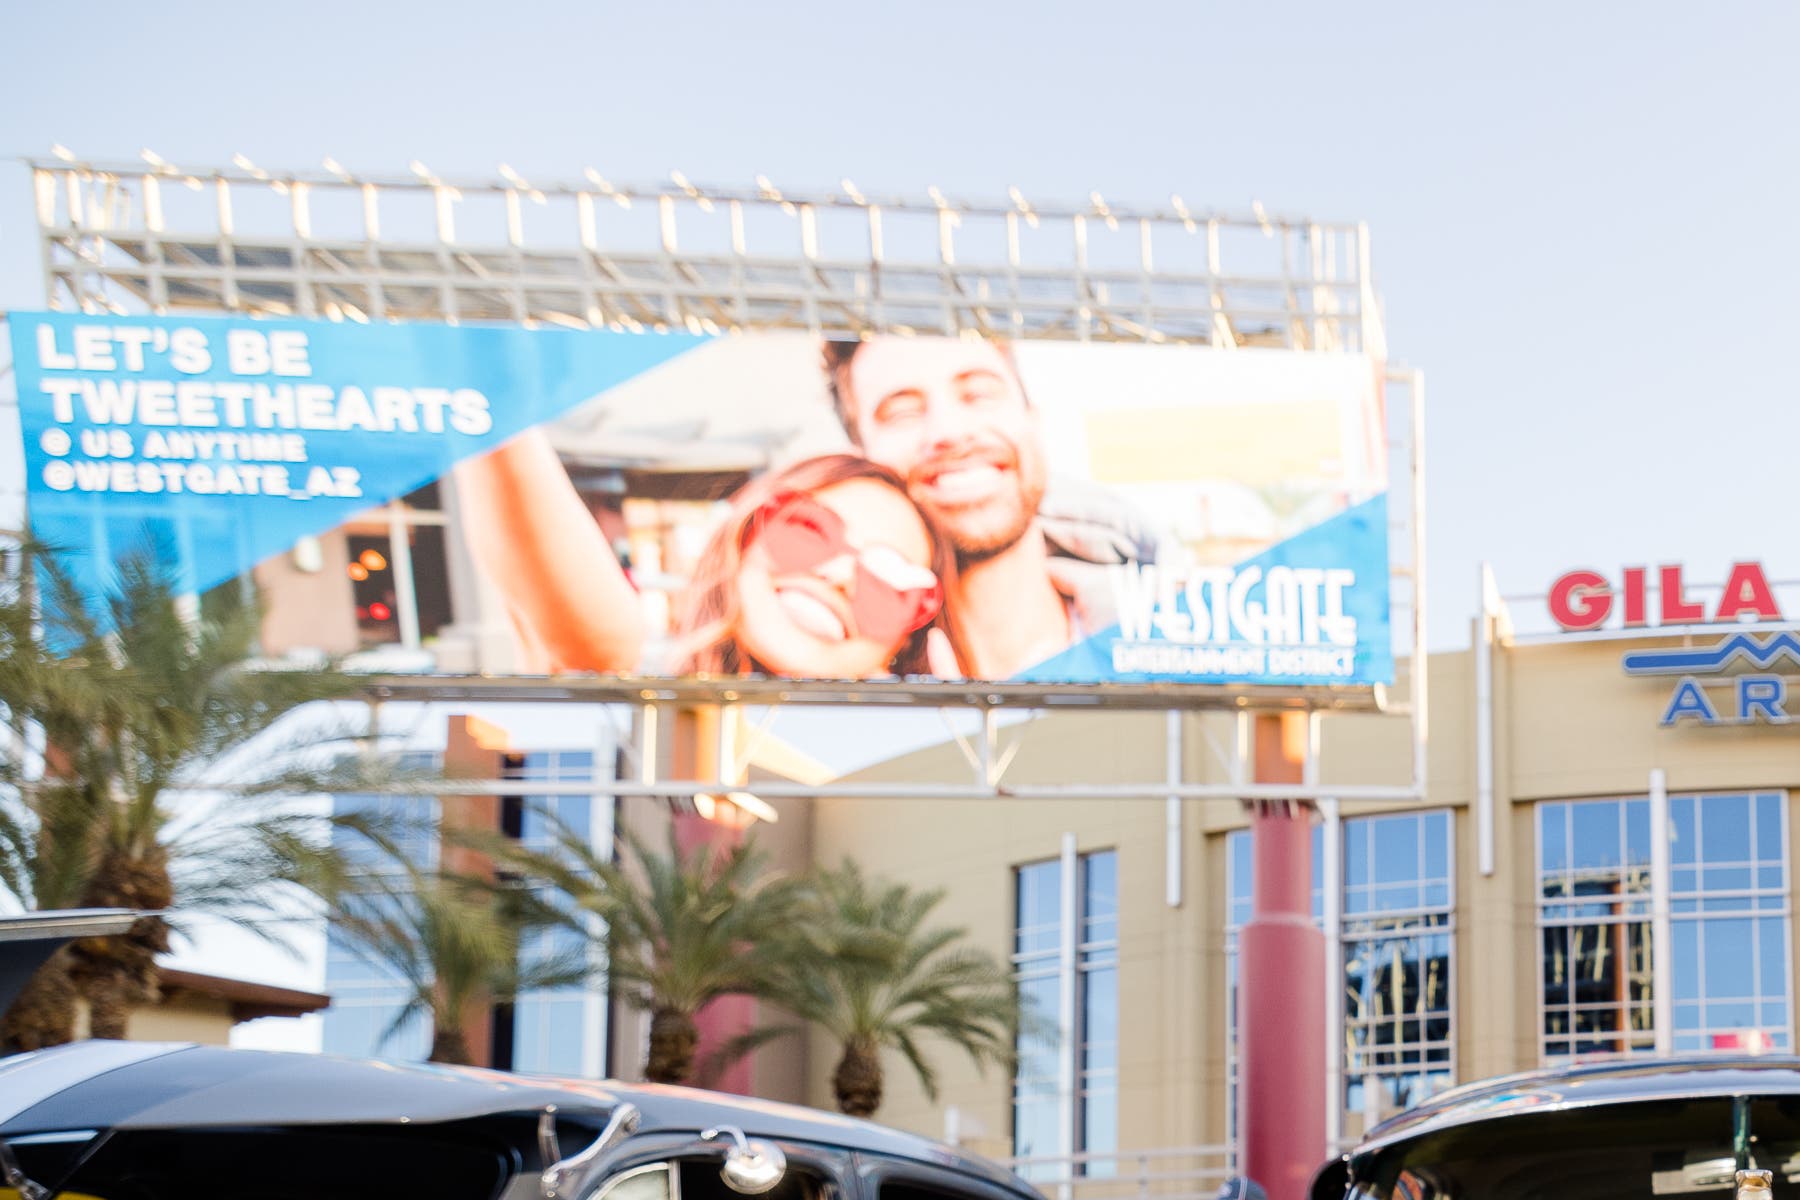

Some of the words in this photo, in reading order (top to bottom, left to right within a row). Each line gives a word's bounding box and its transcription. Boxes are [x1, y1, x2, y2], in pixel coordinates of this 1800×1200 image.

[36, 323, 212, 375] LET'S
[227, 329, 312, 377] BE
[39, 378, 492, 436] TWEETHEARTS
[81, 429, 135, 459] US
[143, 431, 308, 463] ANYTIME
[1109, 562, 1357, 647] WESTGATE
[1547, 561, 1784, 632] GILA
